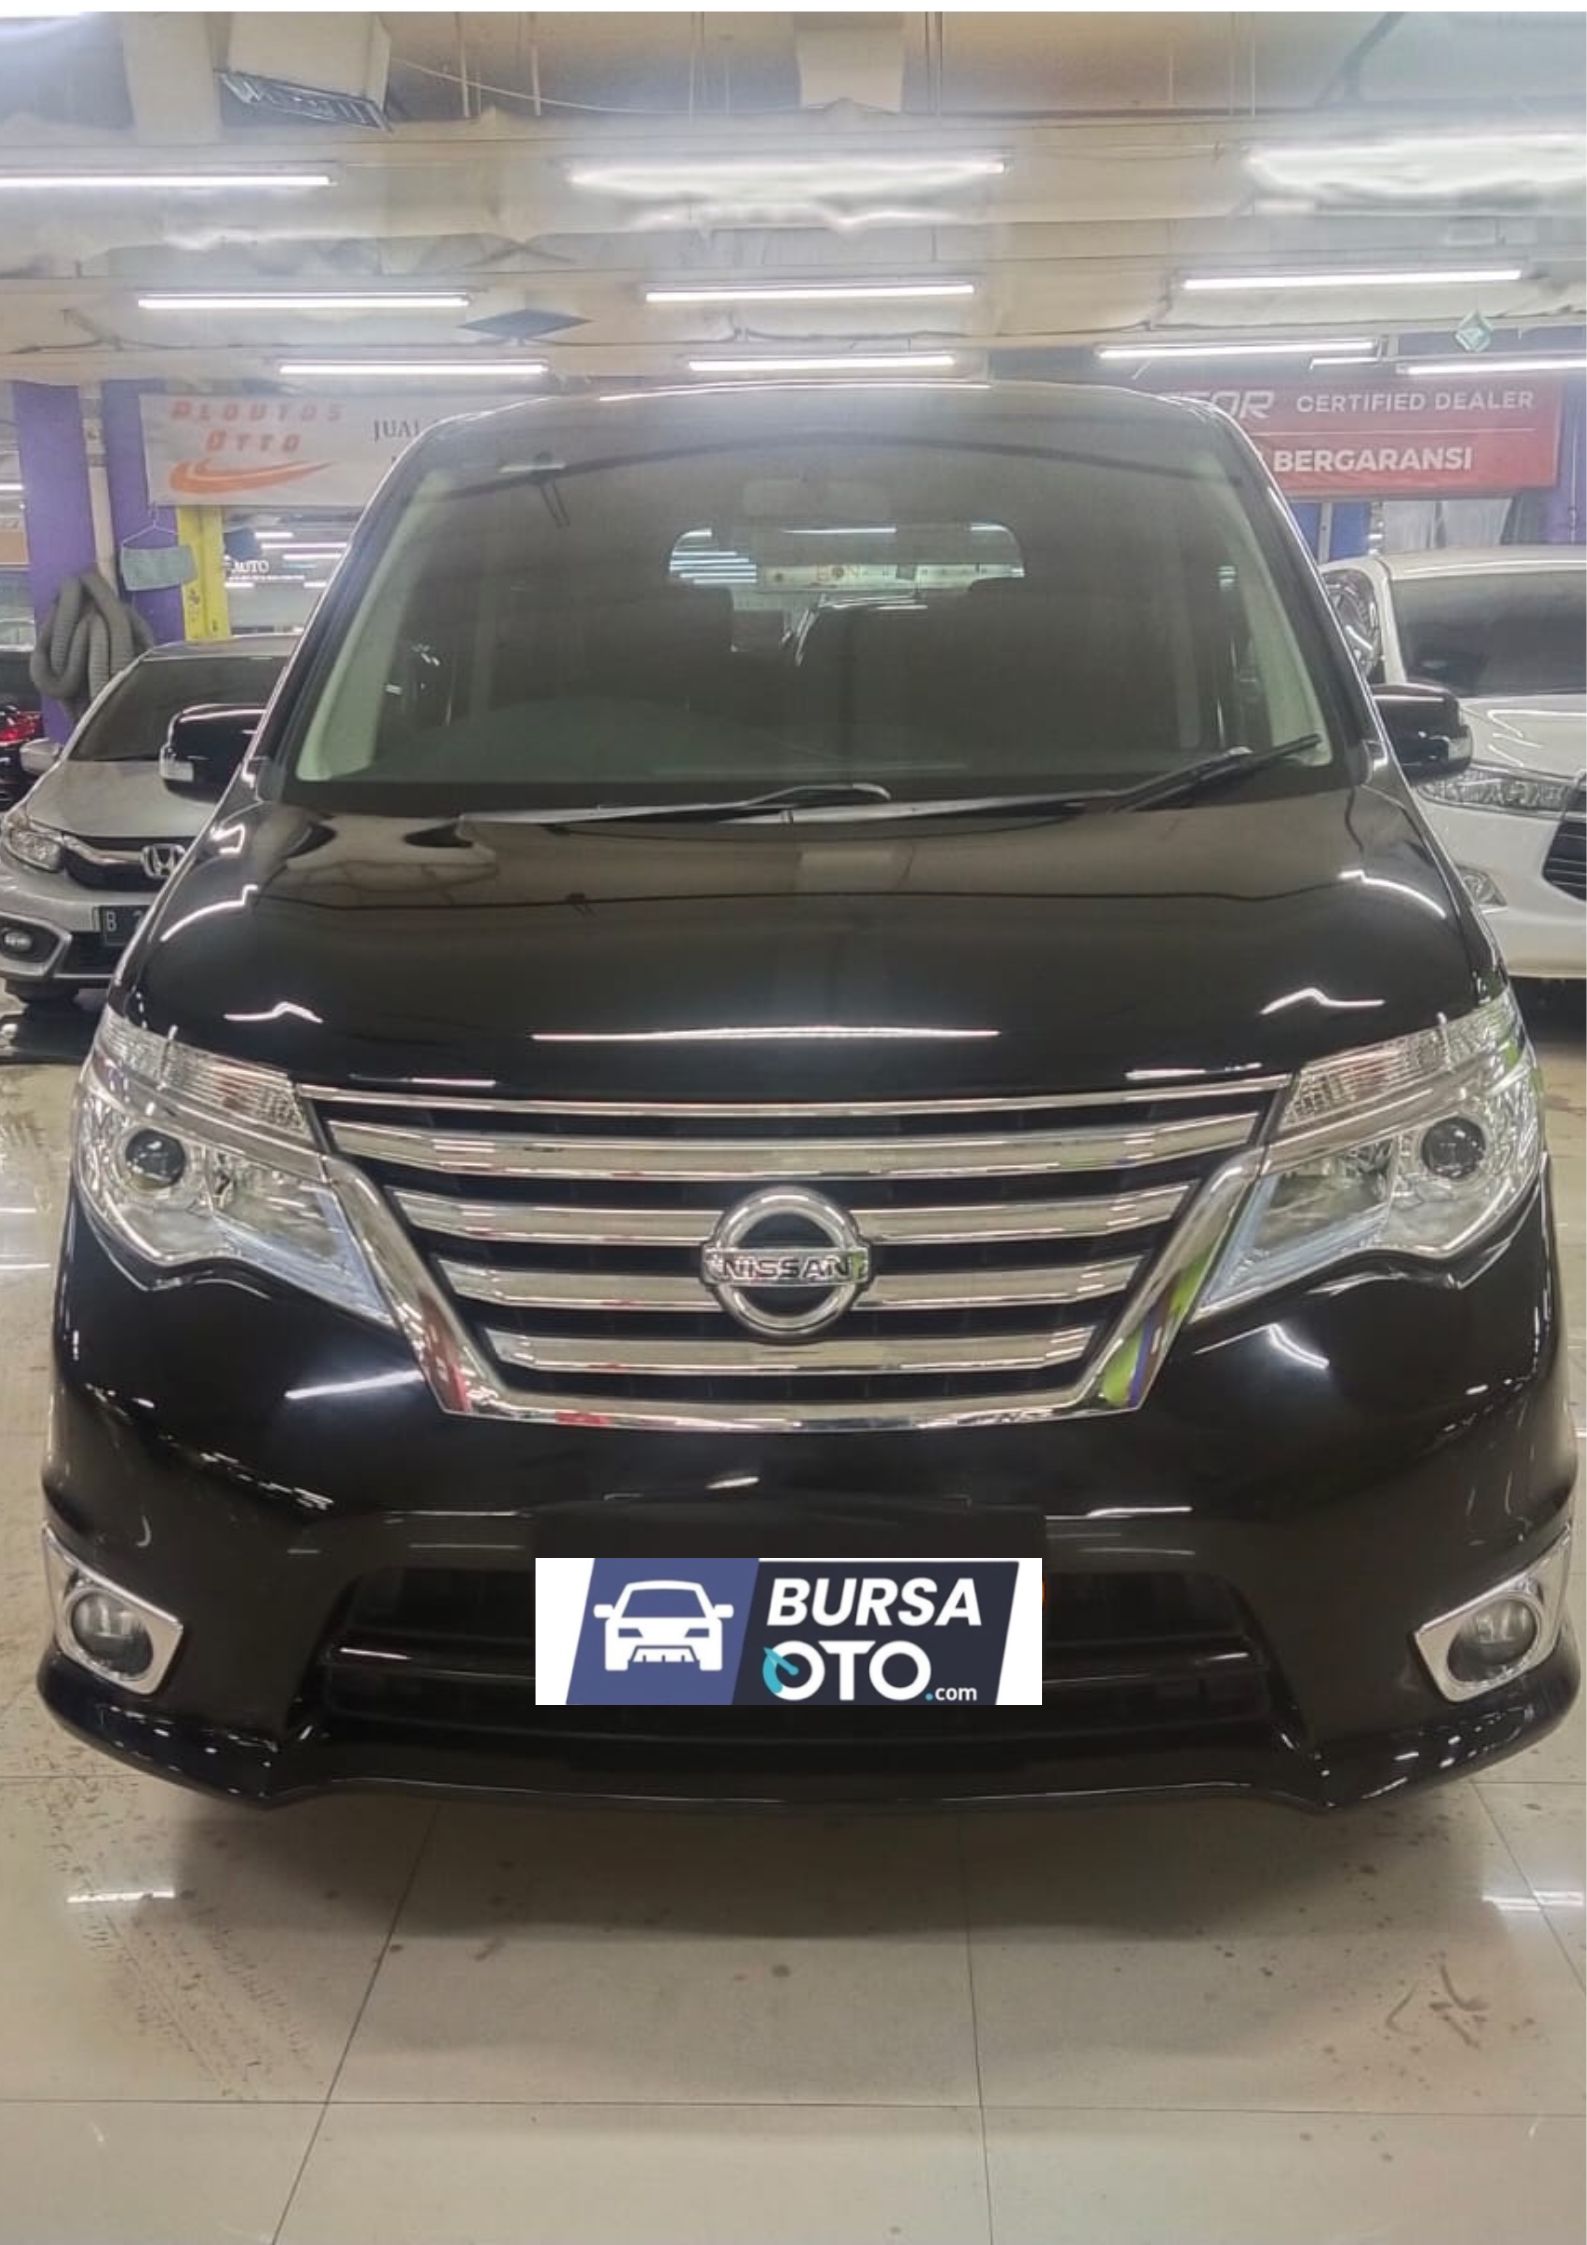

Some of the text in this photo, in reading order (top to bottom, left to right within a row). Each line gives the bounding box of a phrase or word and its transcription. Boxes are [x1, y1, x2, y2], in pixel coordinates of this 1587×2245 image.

[1183, 391, 1533, 418] OR CERTIFIED DEALER
[1274, 447, 1473, 472] BERGARANSI
[106, 911, 117, 932] B
[722, 1253, 851, 1281] NISSAN
